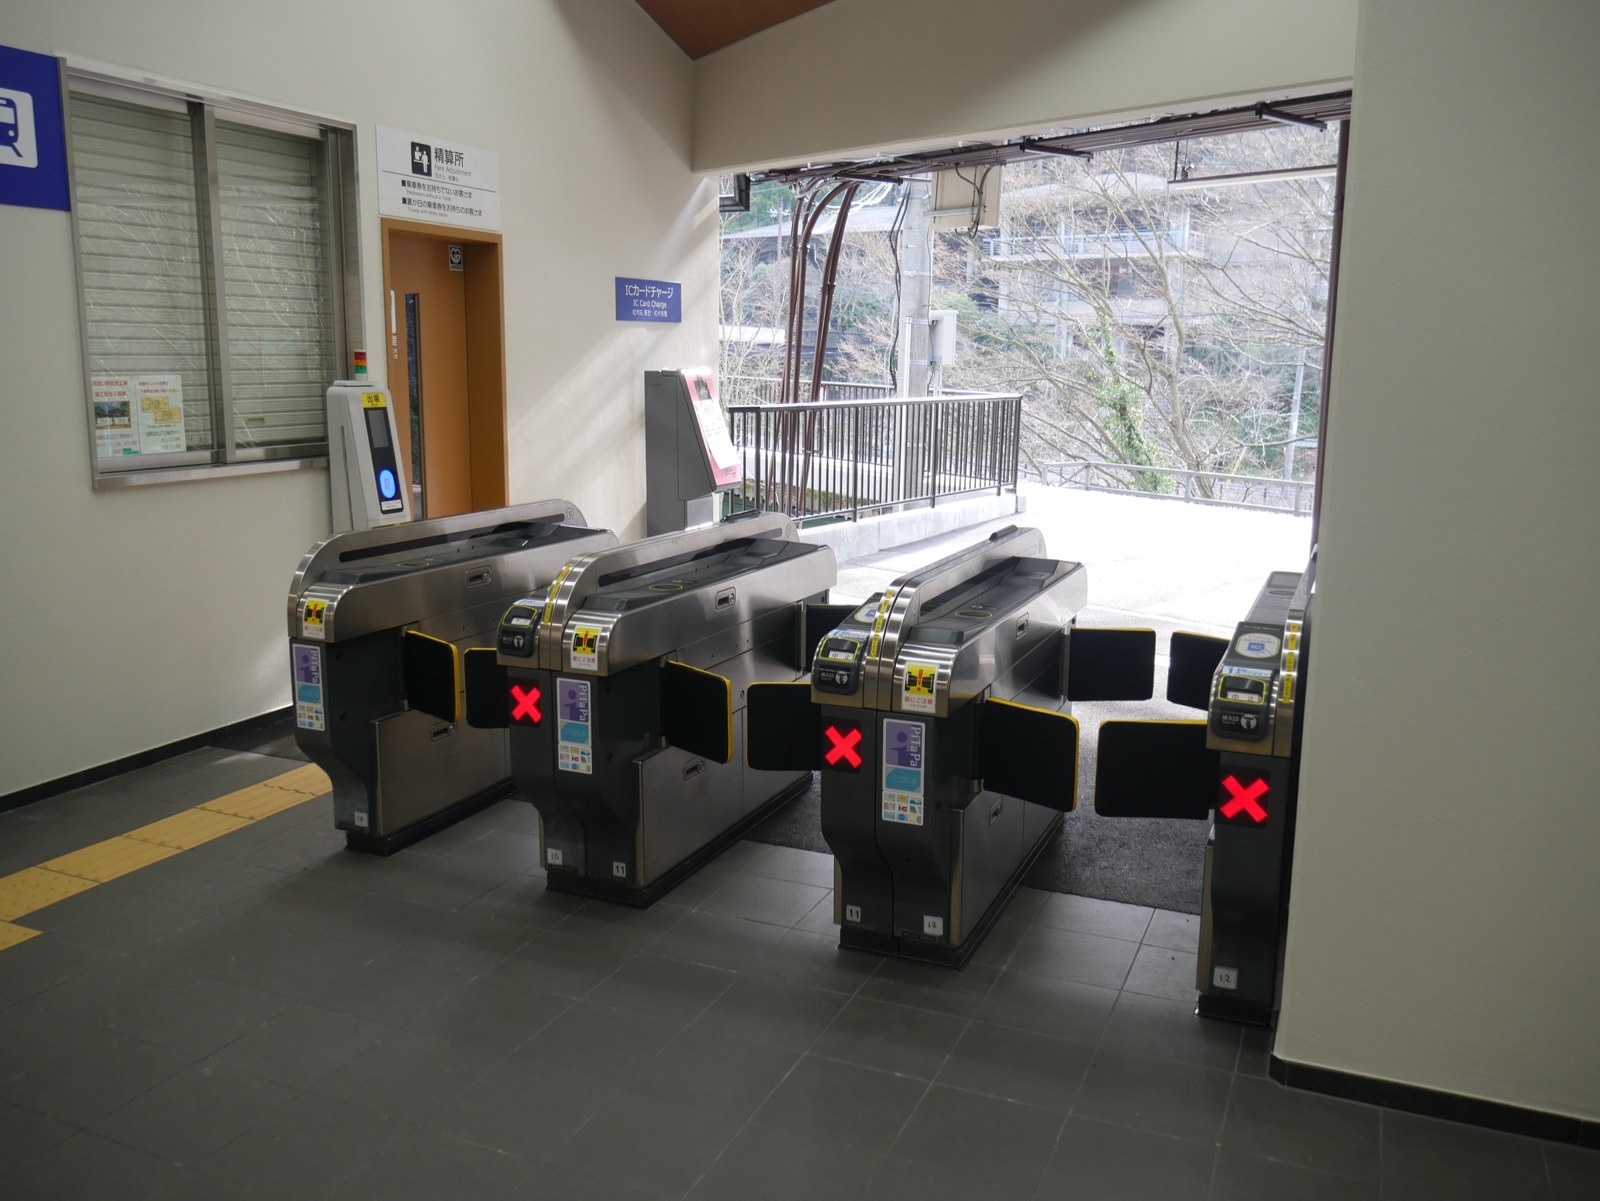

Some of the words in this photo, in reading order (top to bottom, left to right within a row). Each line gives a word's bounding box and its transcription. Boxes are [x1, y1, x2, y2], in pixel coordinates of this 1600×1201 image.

[433, 147, 464, 168] 精算所
[434, 164, 445, 172] Fare
[446, 166, 472, 177] Adjustment
[625, 284, 674, 299] ICカードチャージ
[633, 299, 639, 307] IC
[640, 299, 650, 308] Card
[651, 300, 668, 309] Charge
[579, 684, 588, 721] PiTaPa
[910, 725, 922, 767] PiTaPa
[616, 865, 625, 875] 11
[849, 908, 859, 919] 11
[928, 921, 938, 929] 12
[1220, 973, 1232, 984] 12
